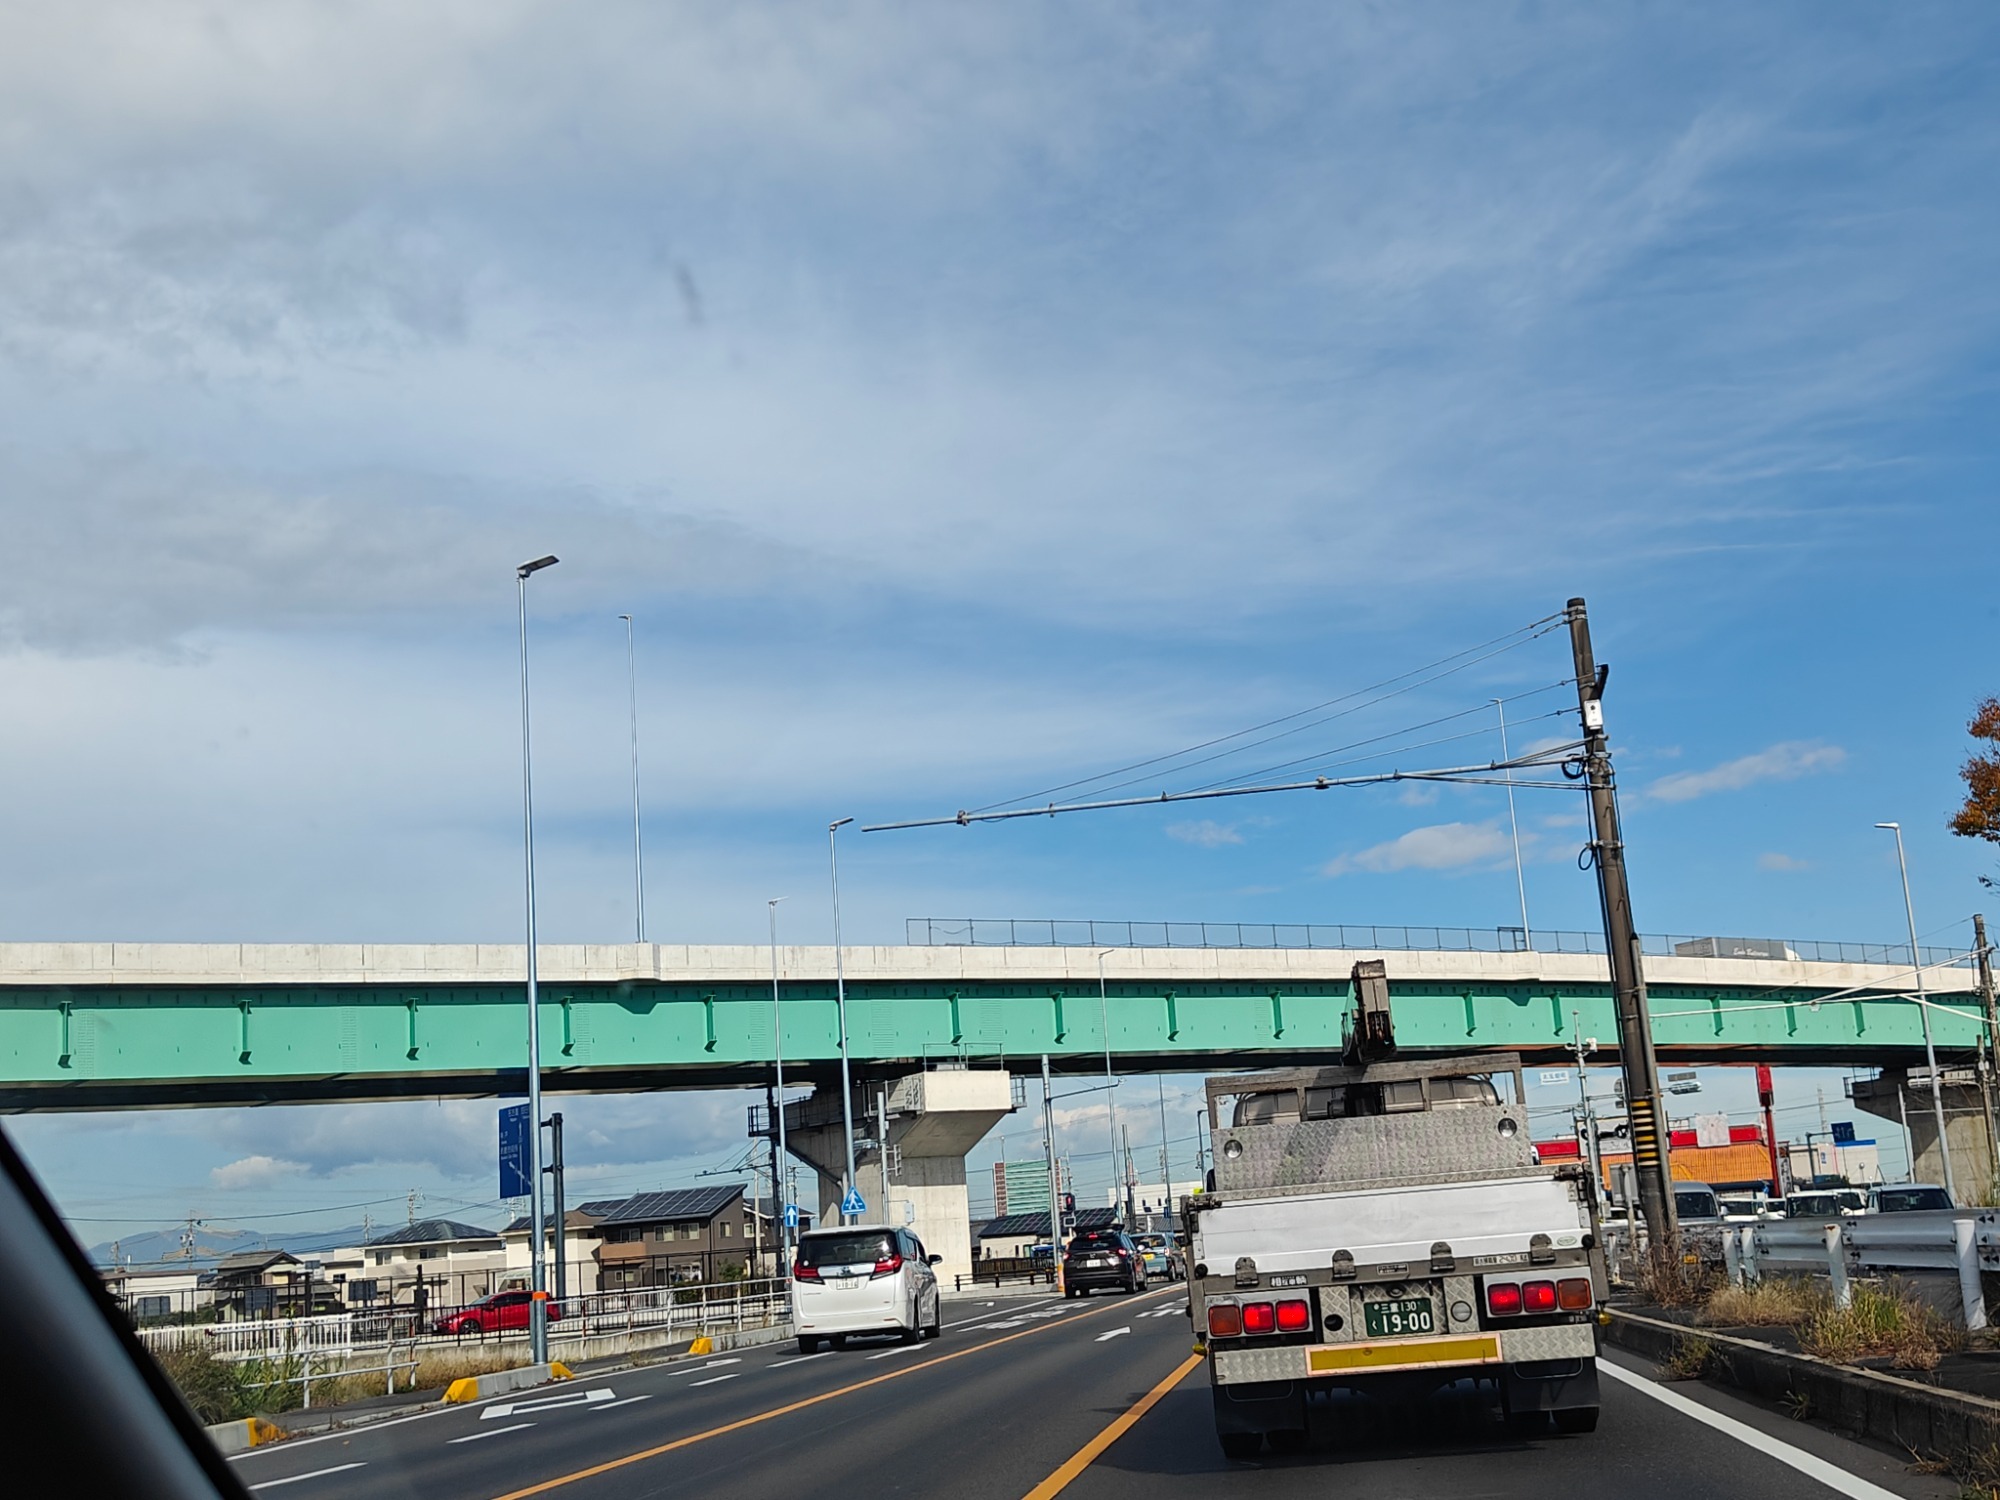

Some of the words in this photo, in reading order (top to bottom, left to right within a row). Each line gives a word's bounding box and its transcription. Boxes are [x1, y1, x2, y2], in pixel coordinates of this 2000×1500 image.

[1400, 1301, 1417, 1312] 130
[1372, 1320, 1378, 1331] く
[1382, 1312, 1431, 1334] 19-00
